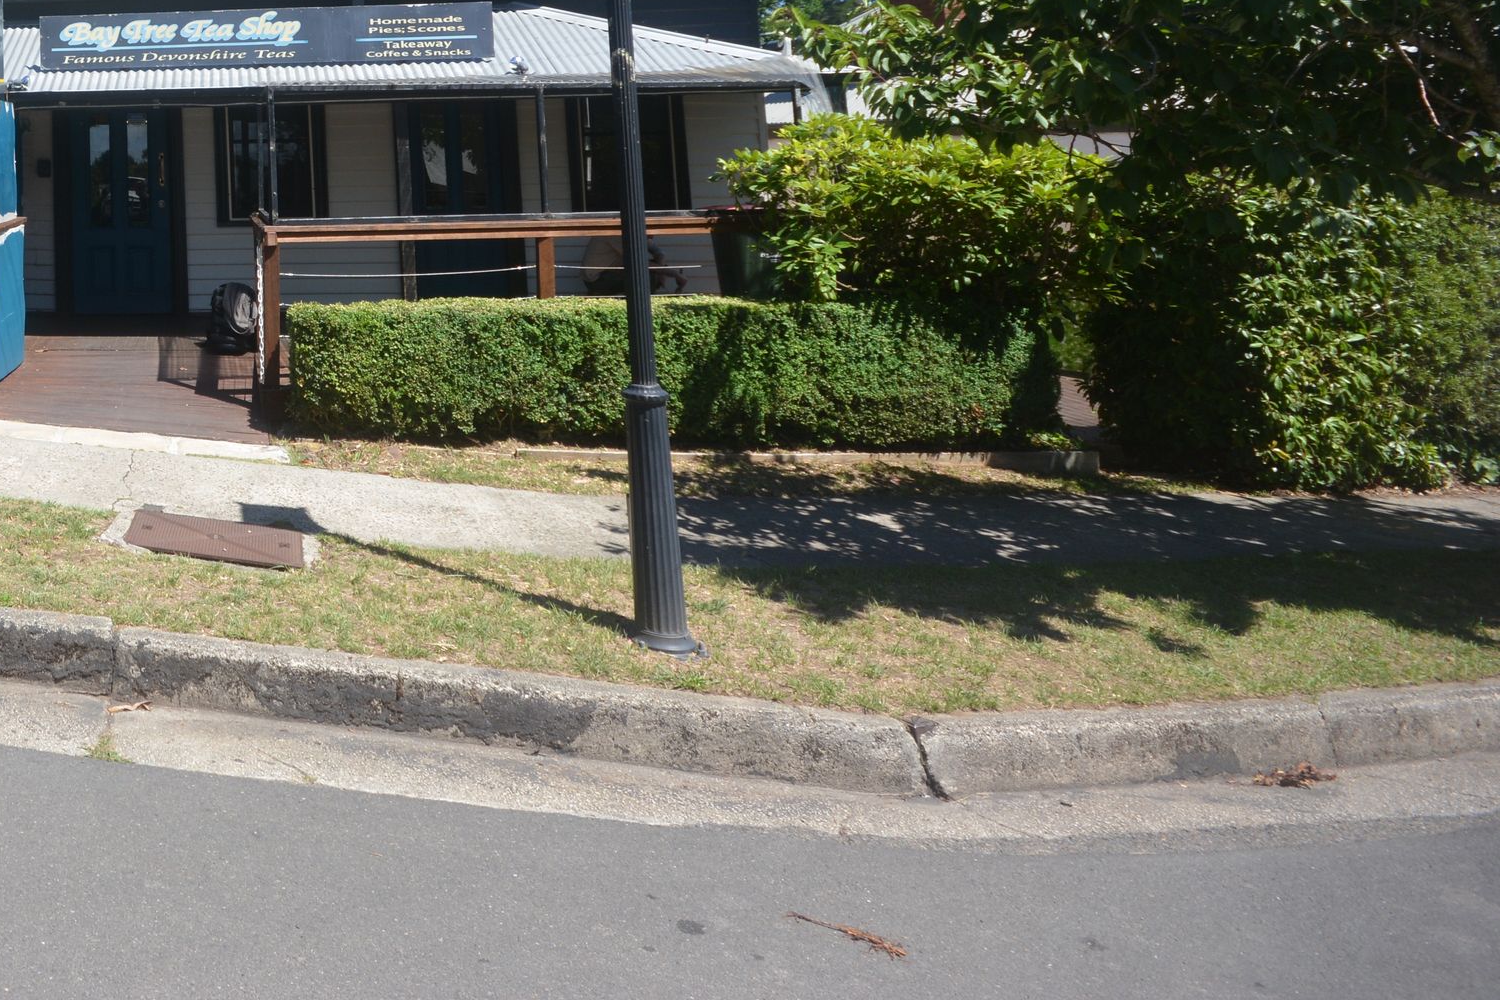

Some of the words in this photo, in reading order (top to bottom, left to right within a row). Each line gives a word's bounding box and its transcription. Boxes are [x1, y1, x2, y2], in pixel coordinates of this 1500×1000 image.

[369, 16, 463, 26] Homemade
[59, 22, 121, 51] Bay
[121, 19, 178, 43] Tree
[180, 19, 234, 42] Tea
[235, 11, 301, 46] Shop
[383, 40, 452, 49] Takeaway
[62, 54, 135, 65] Famous
[140, 49, 247, 63] Devonshire
[254, 49, 296, 60] Teas
[366, 50, 409, 58] Coffee
[411, 49, 422, 57] &
[424, 48, 472, 57] Snacks
